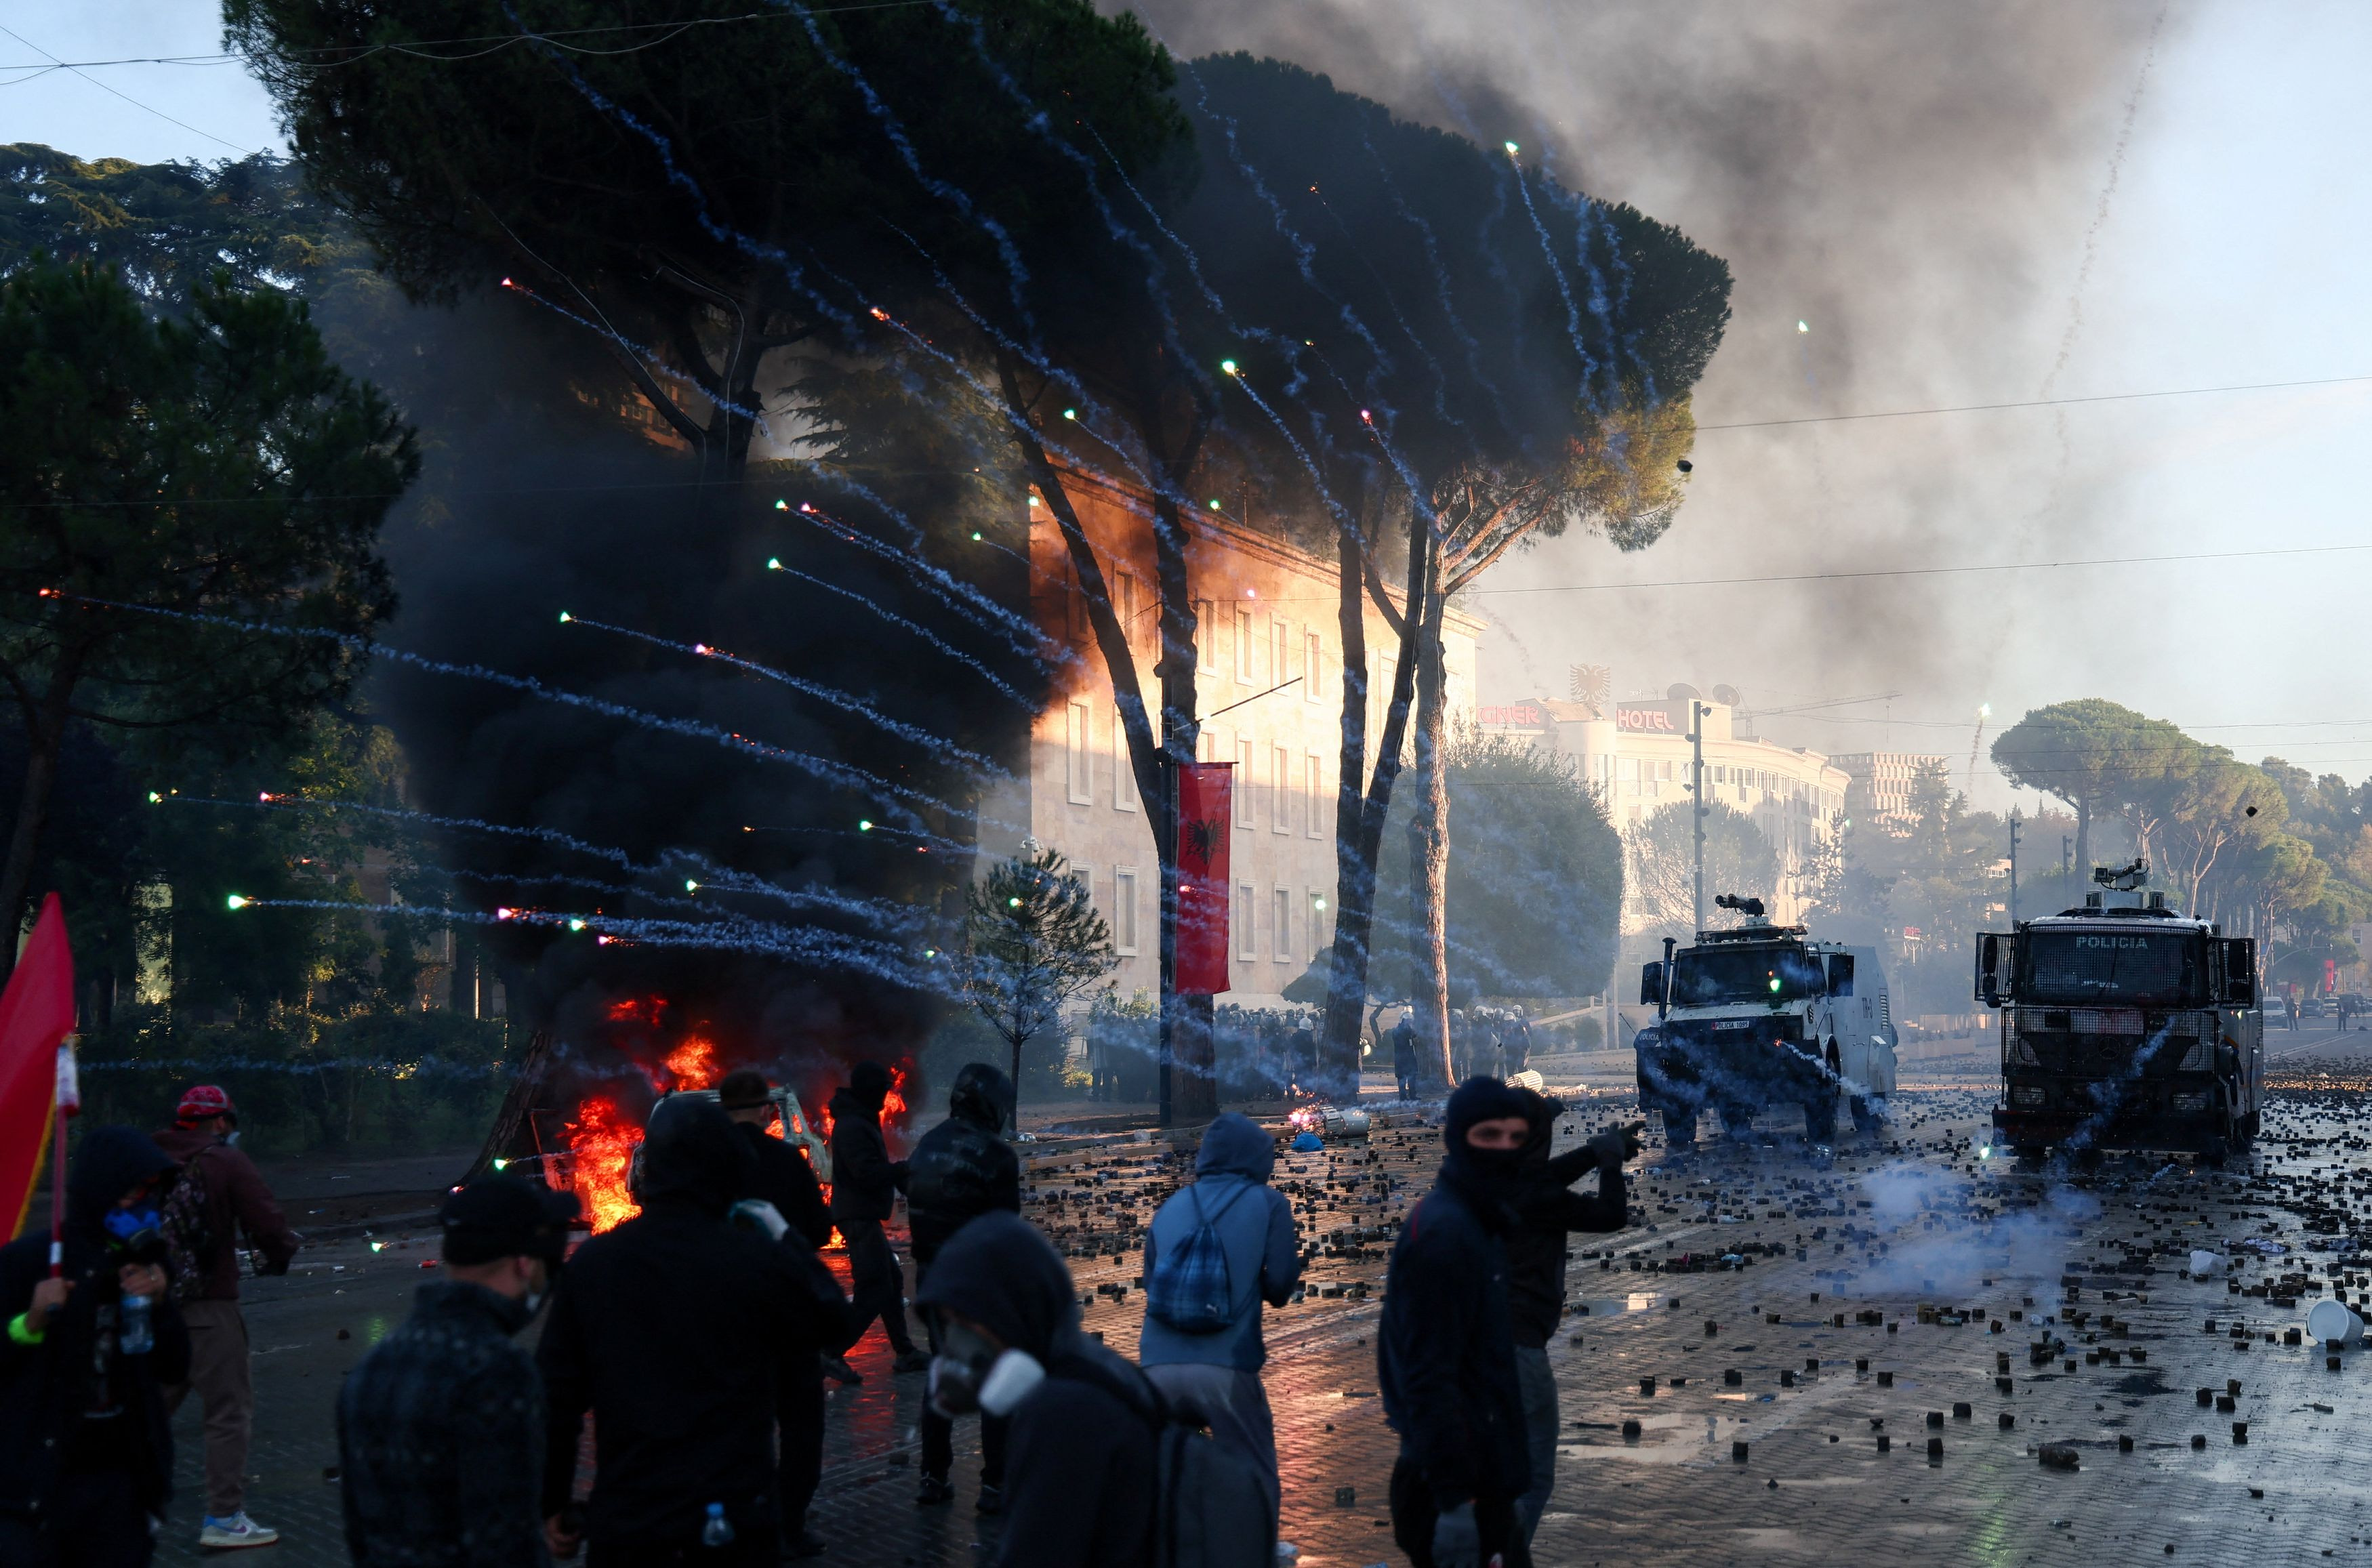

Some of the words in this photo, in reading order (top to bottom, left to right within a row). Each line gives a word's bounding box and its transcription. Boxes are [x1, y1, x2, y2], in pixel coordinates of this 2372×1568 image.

[1477, 705, 1540, 724] GNER
[1616, 709, 1674, 730] HOTEL
[2076, 936, 2148, 949] POLICIA
